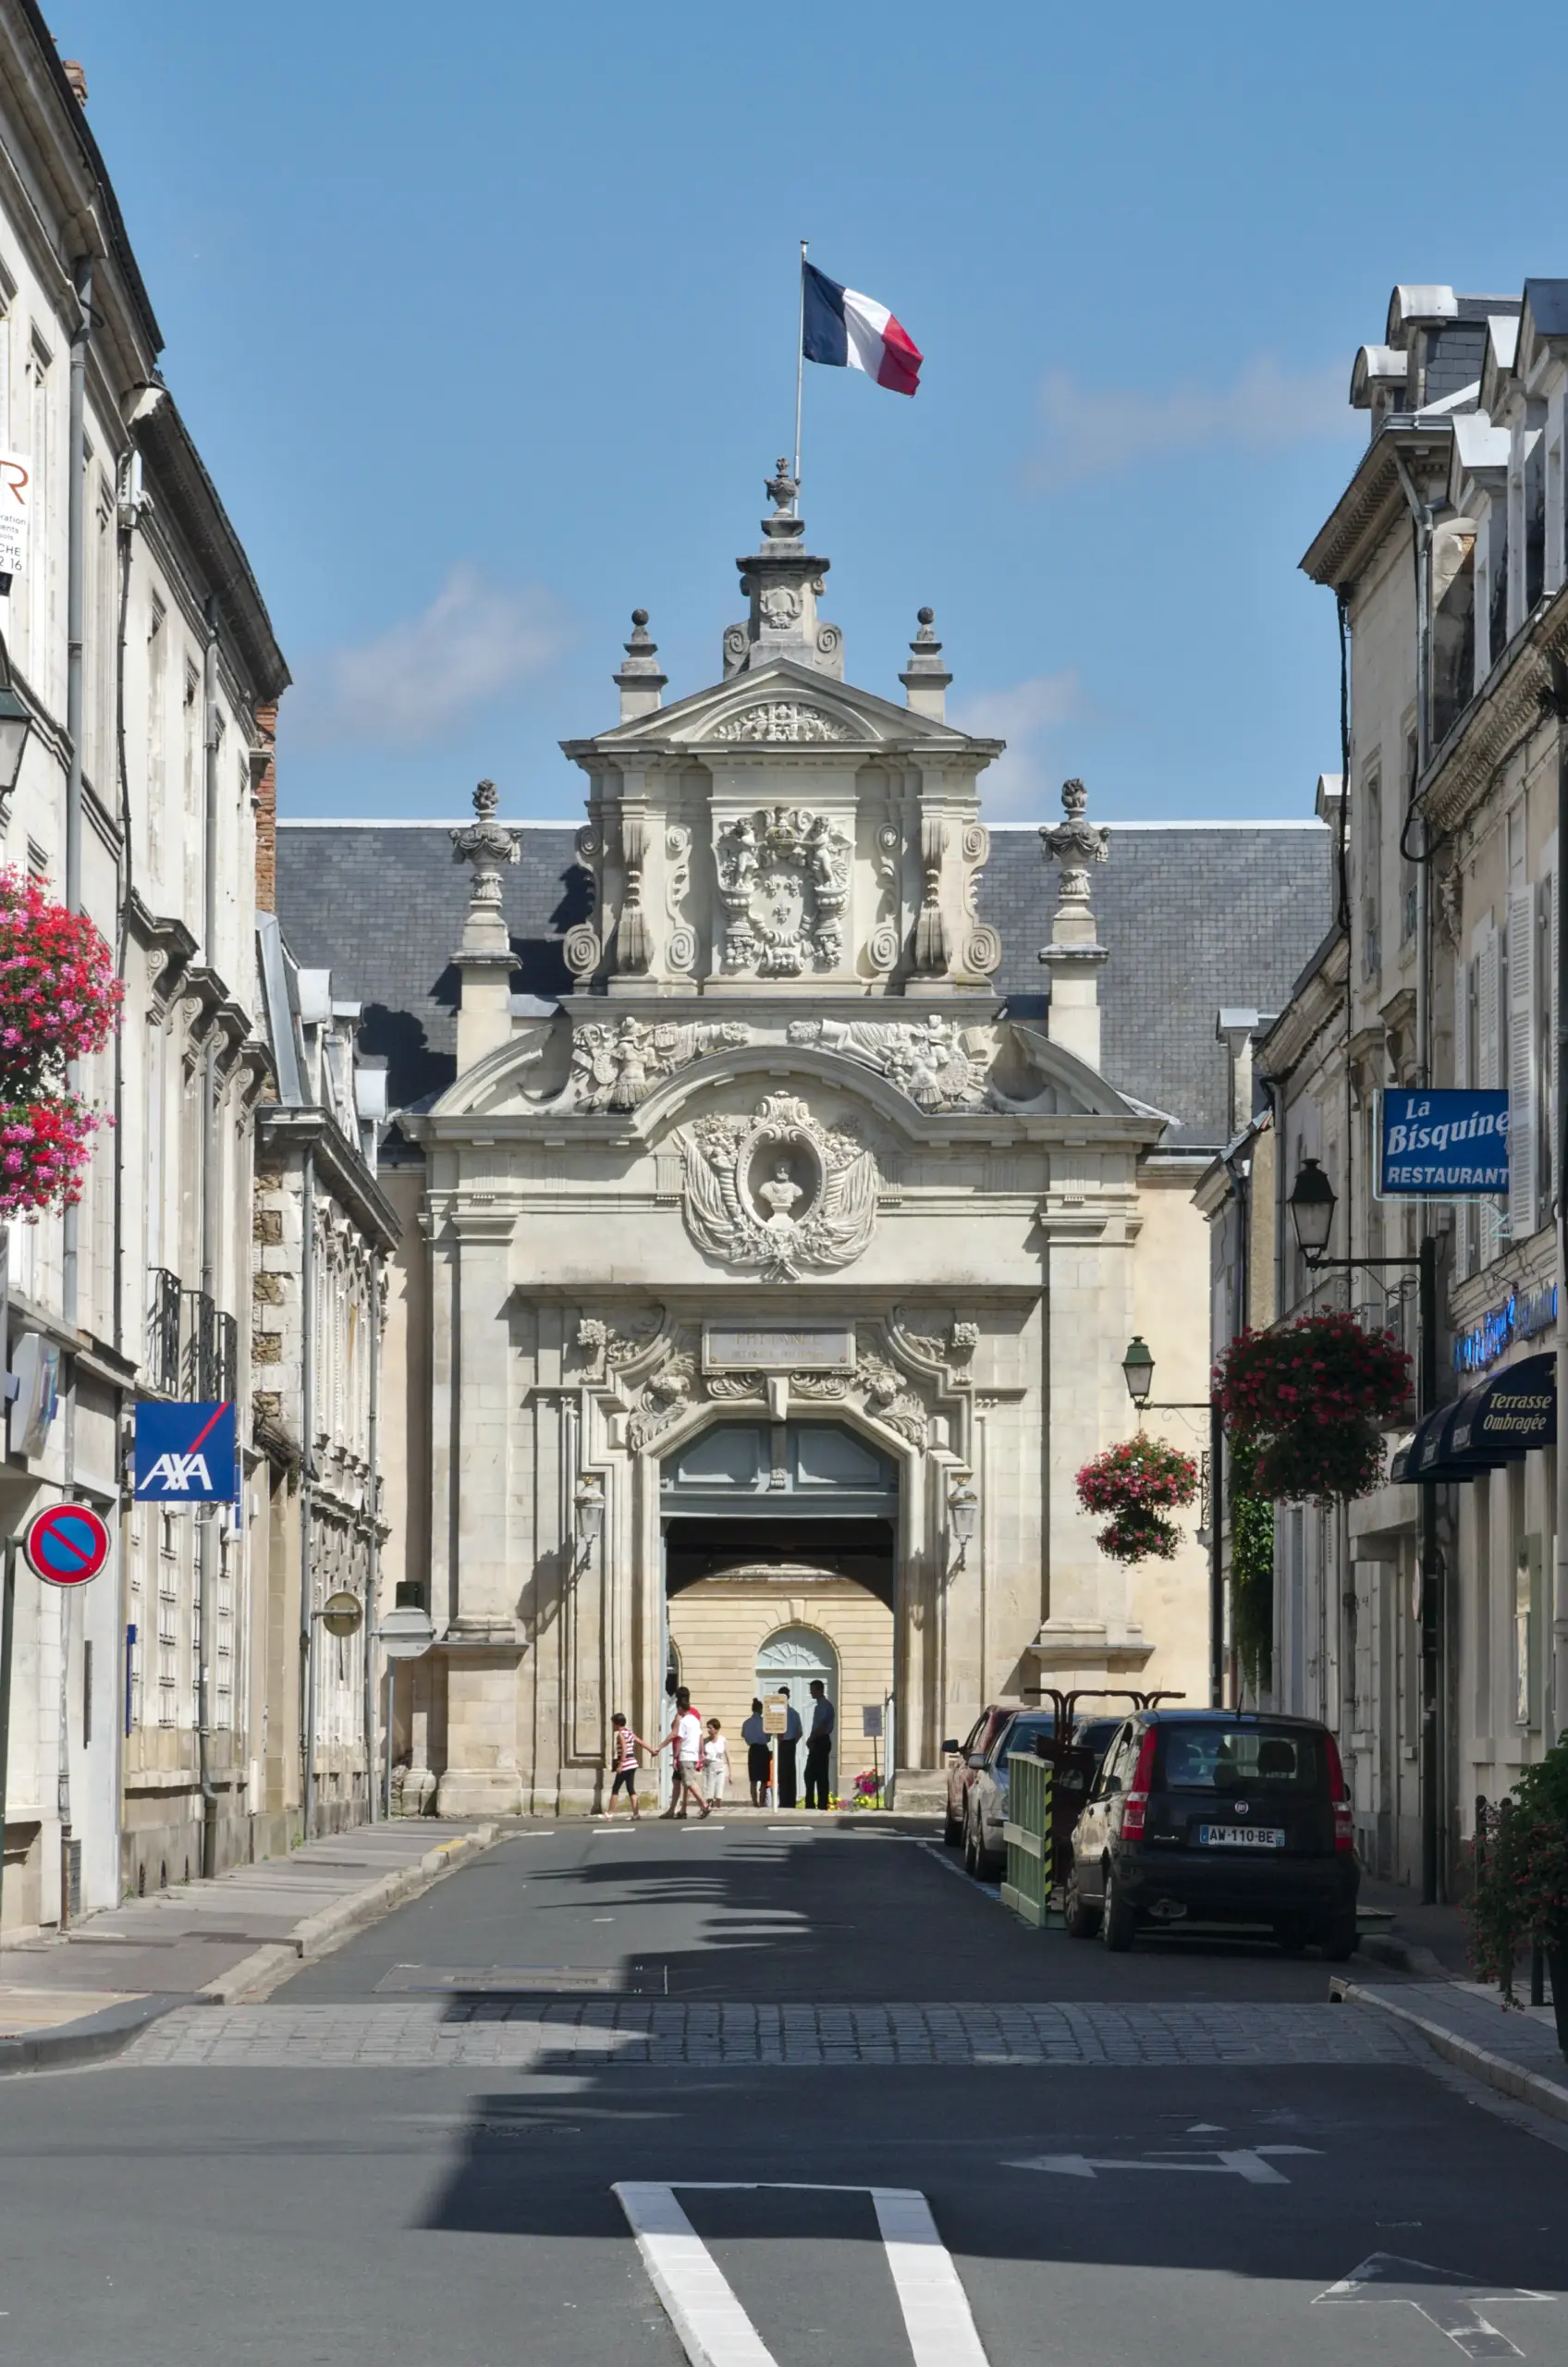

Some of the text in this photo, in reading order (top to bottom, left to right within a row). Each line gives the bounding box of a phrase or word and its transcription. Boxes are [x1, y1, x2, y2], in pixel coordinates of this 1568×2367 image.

[10, 558, 22, 570] 16
[1405, 1098, 1430, 1120] La
[1387, 1110, 1509, 1156] Bisquine
[1387, 1167, 1509, 1184] RESTAURANT
[1489, 1393, 1552, 1409] Terrasse
[1483, 1414, 1547, 1434] Ombragée
[137, 1453, 214, 1490] AXA
[1209, 1828, 1275, 1844] AW-110-BE
